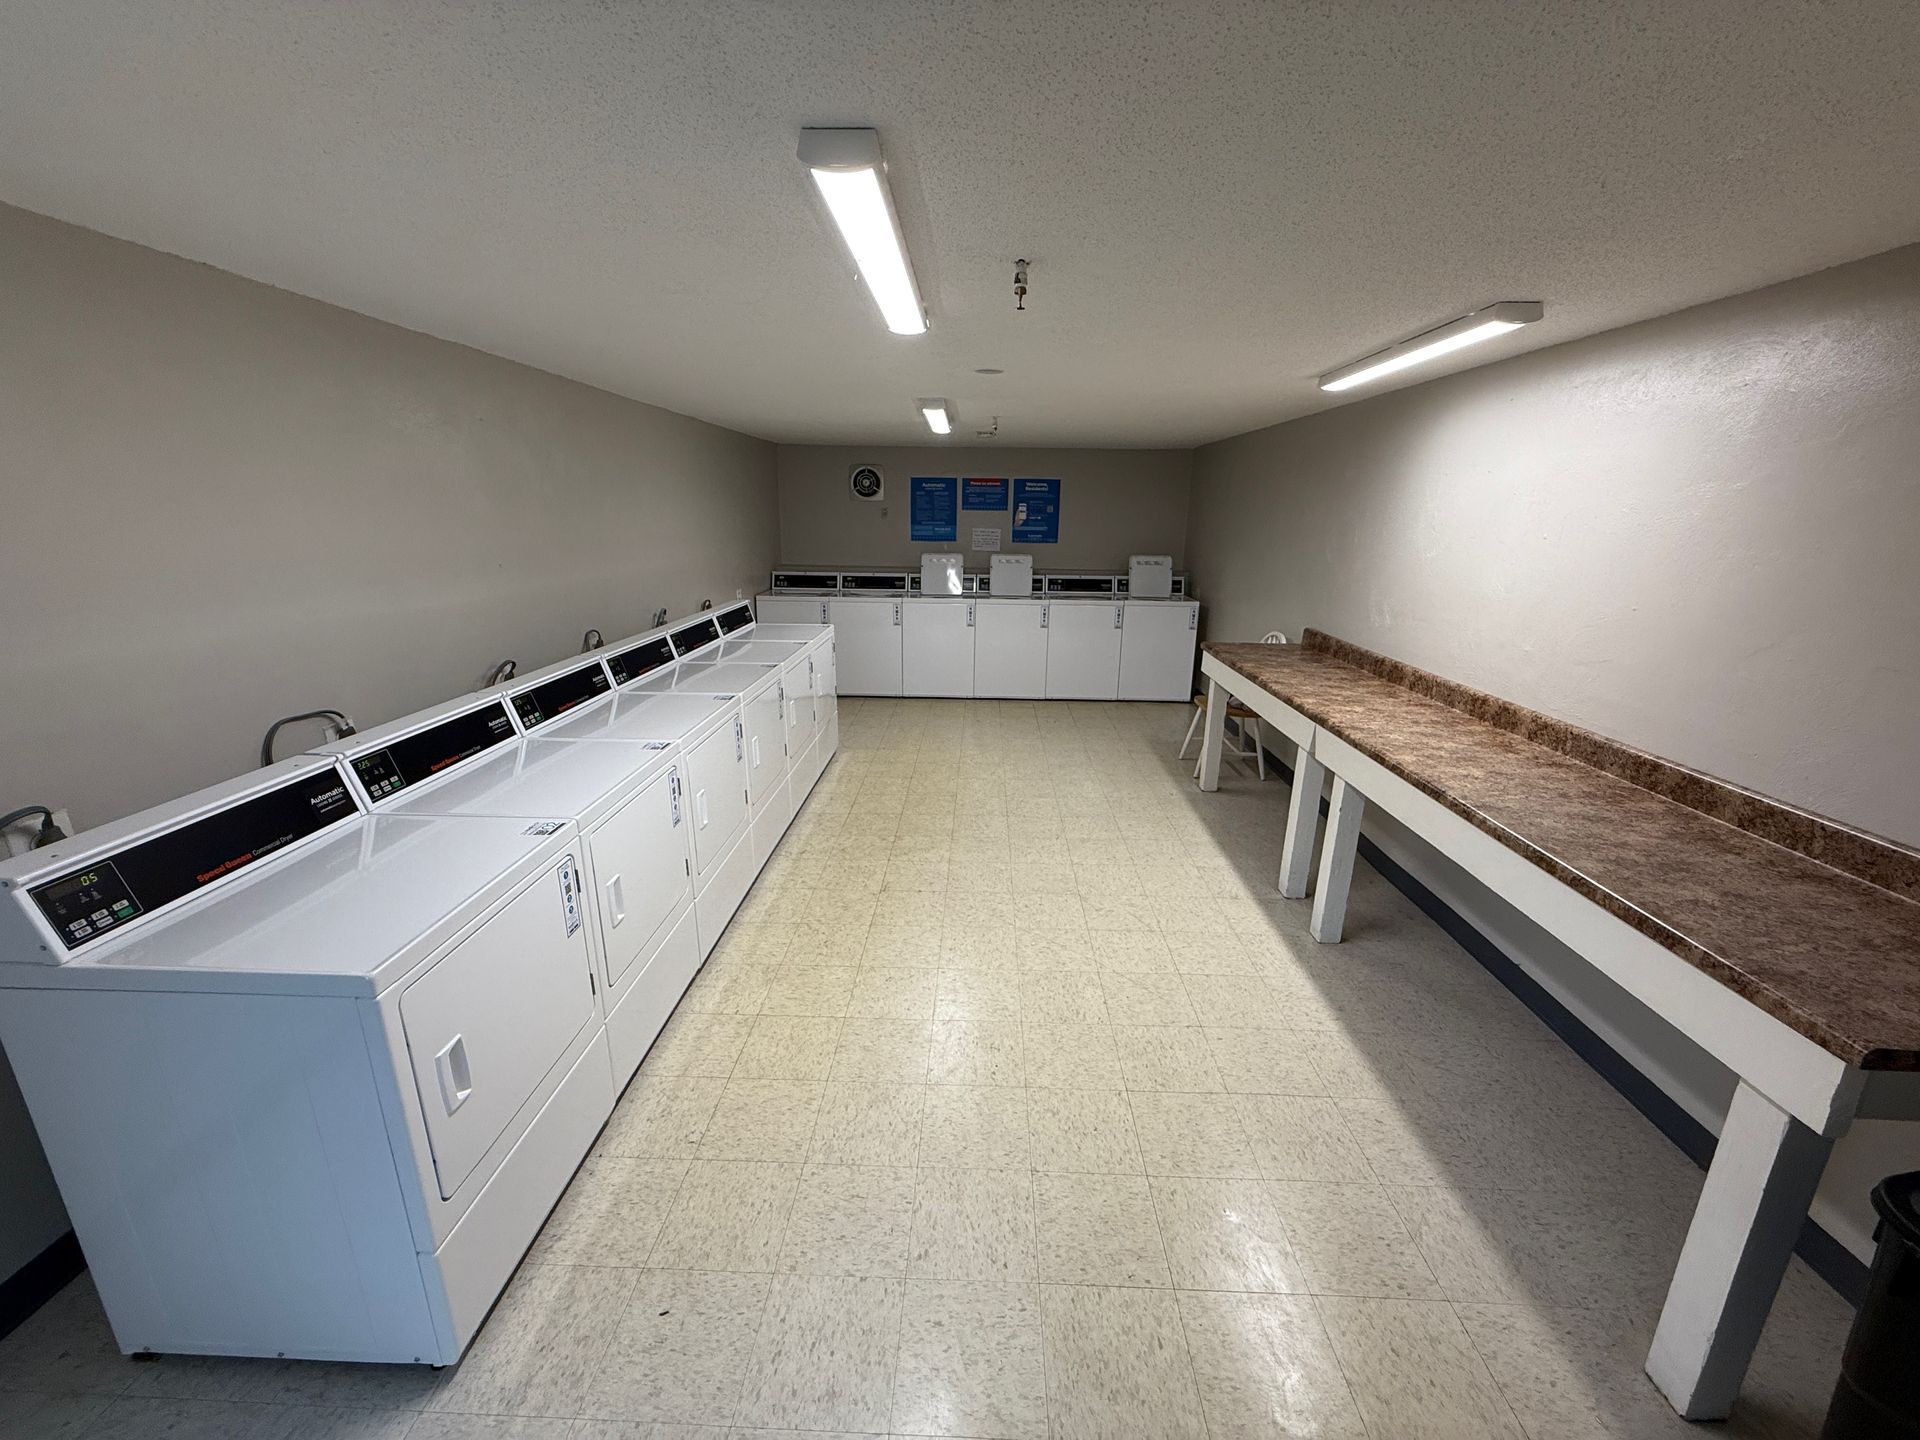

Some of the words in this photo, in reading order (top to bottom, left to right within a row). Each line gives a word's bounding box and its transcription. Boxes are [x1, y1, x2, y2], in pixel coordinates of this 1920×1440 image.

[310, 786, 345, 805] Automatic
[196, 864, 226, 882] Speed
[224, 853, 253, 869] Queen
[252, 839, 281, 856] Commercial
[279, 833, 294, 844] Dryer
